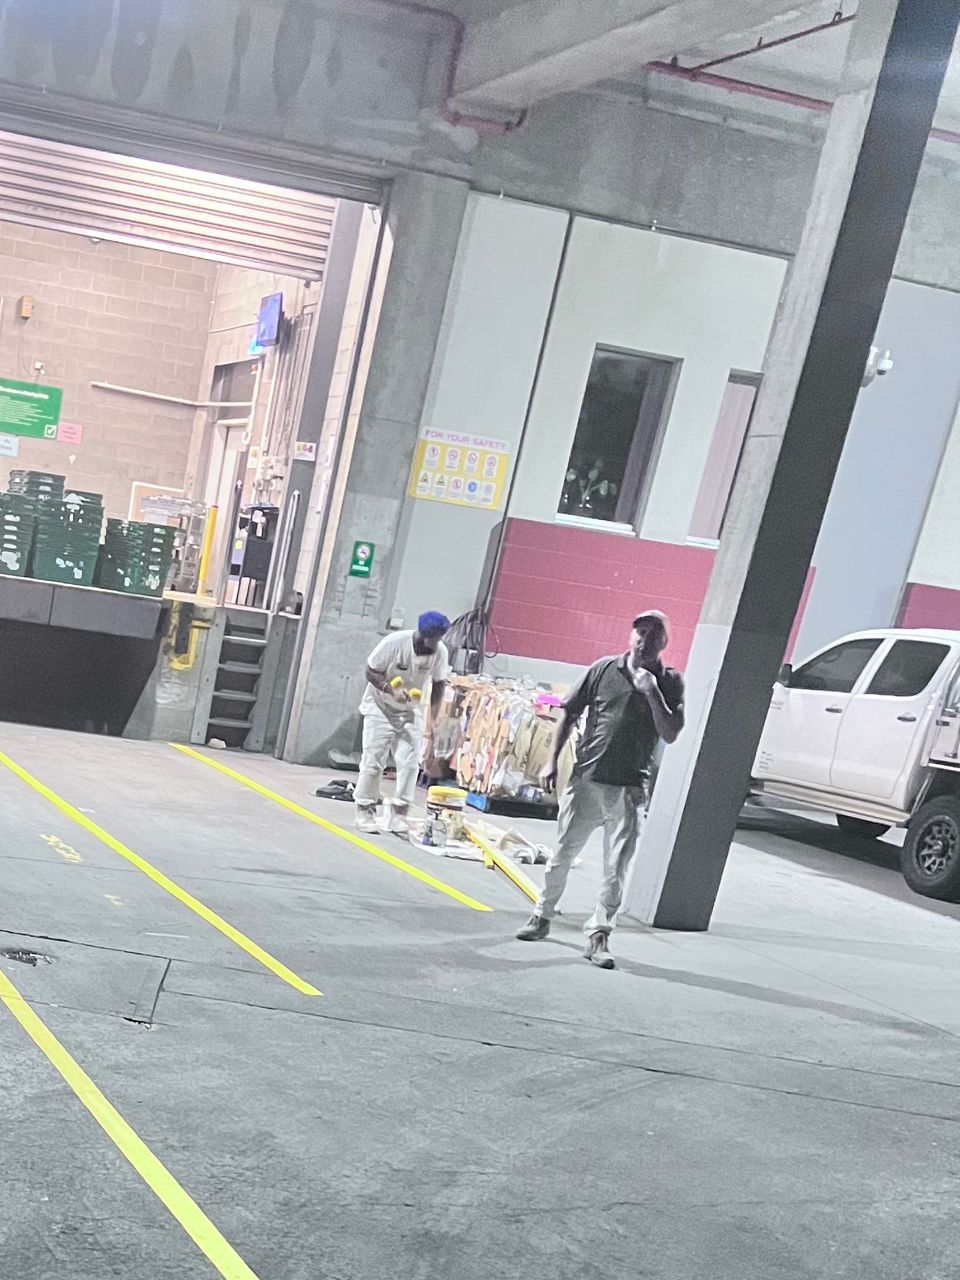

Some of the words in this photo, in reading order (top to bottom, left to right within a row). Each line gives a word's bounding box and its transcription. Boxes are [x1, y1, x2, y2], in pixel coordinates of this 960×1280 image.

[425, 429, 444, 439] FOR
[447, 434, 470, 444] YOUR
[472, 437, 507, 449] SAFETY
